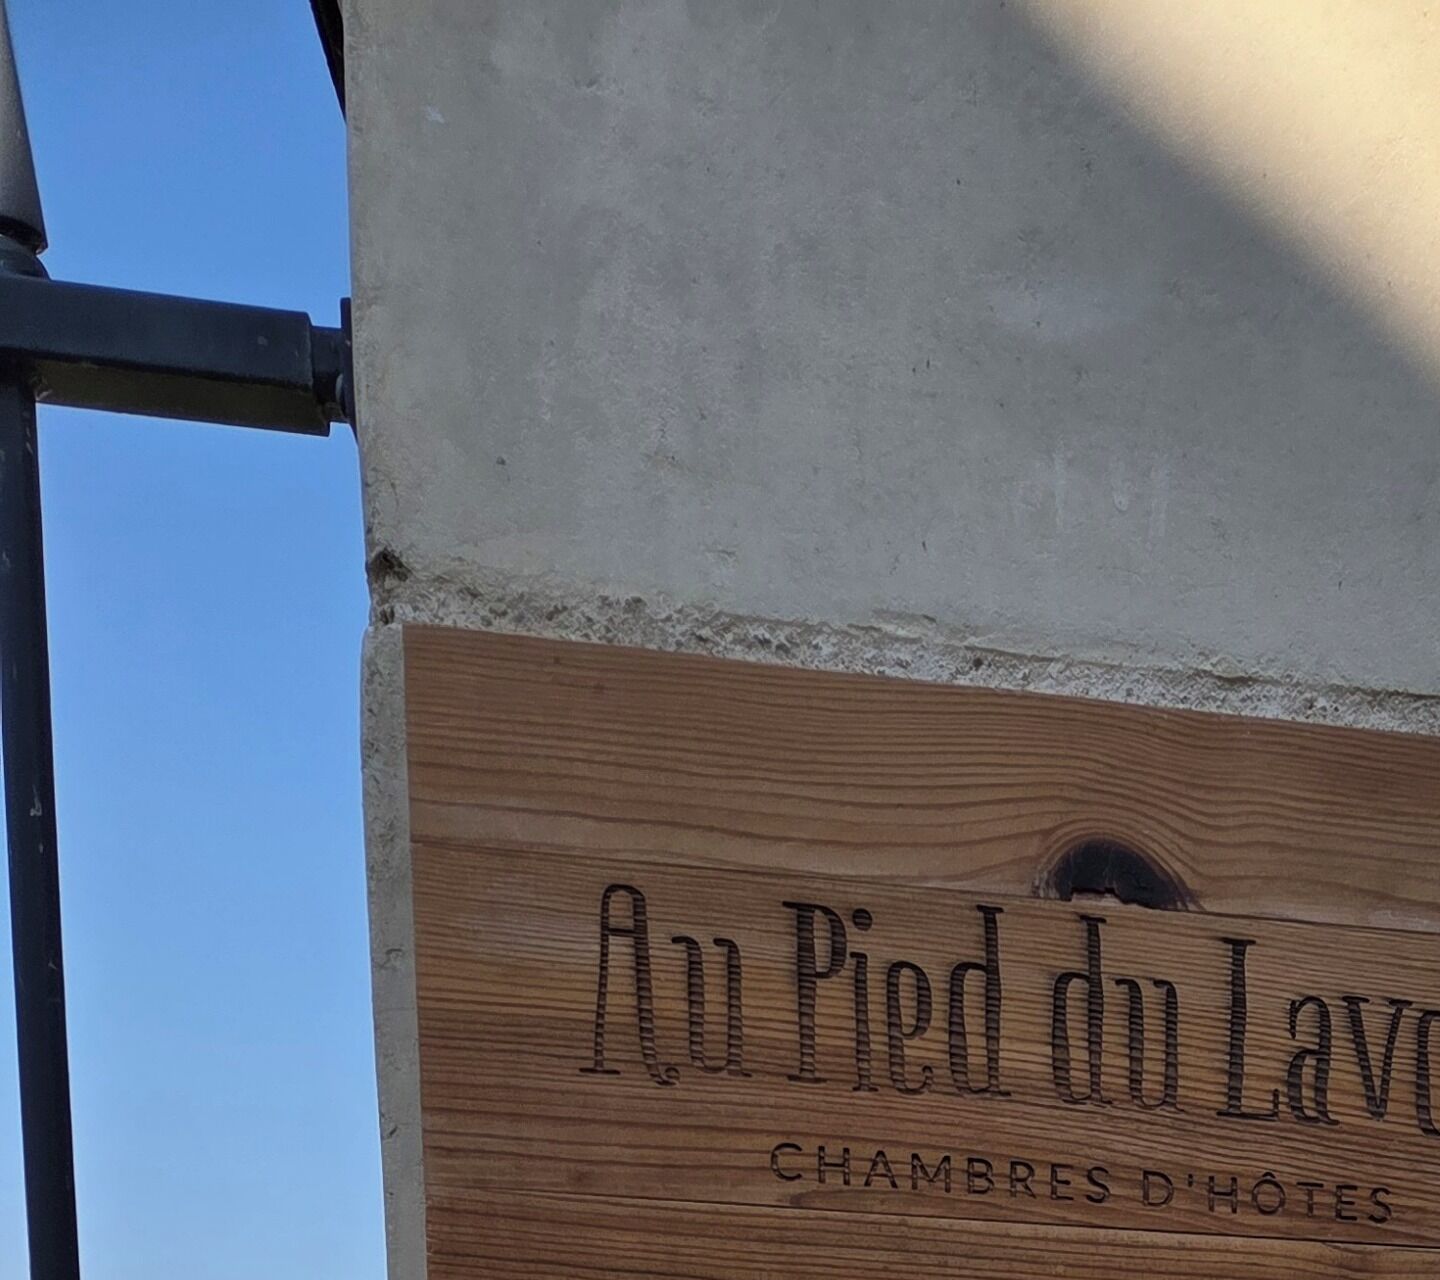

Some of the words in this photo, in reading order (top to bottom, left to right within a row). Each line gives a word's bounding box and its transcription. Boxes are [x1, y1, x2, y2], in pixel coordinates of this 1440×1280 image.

[579, 884, 752, 1086] Au
[782, 901, 1012, 1097] Pied
[1052, 915, 1187, 1113] du
[769, 1142, 1112, 1205] CHAMBRES
[1142, 1170, 1394, 1225] D'HÔTES
